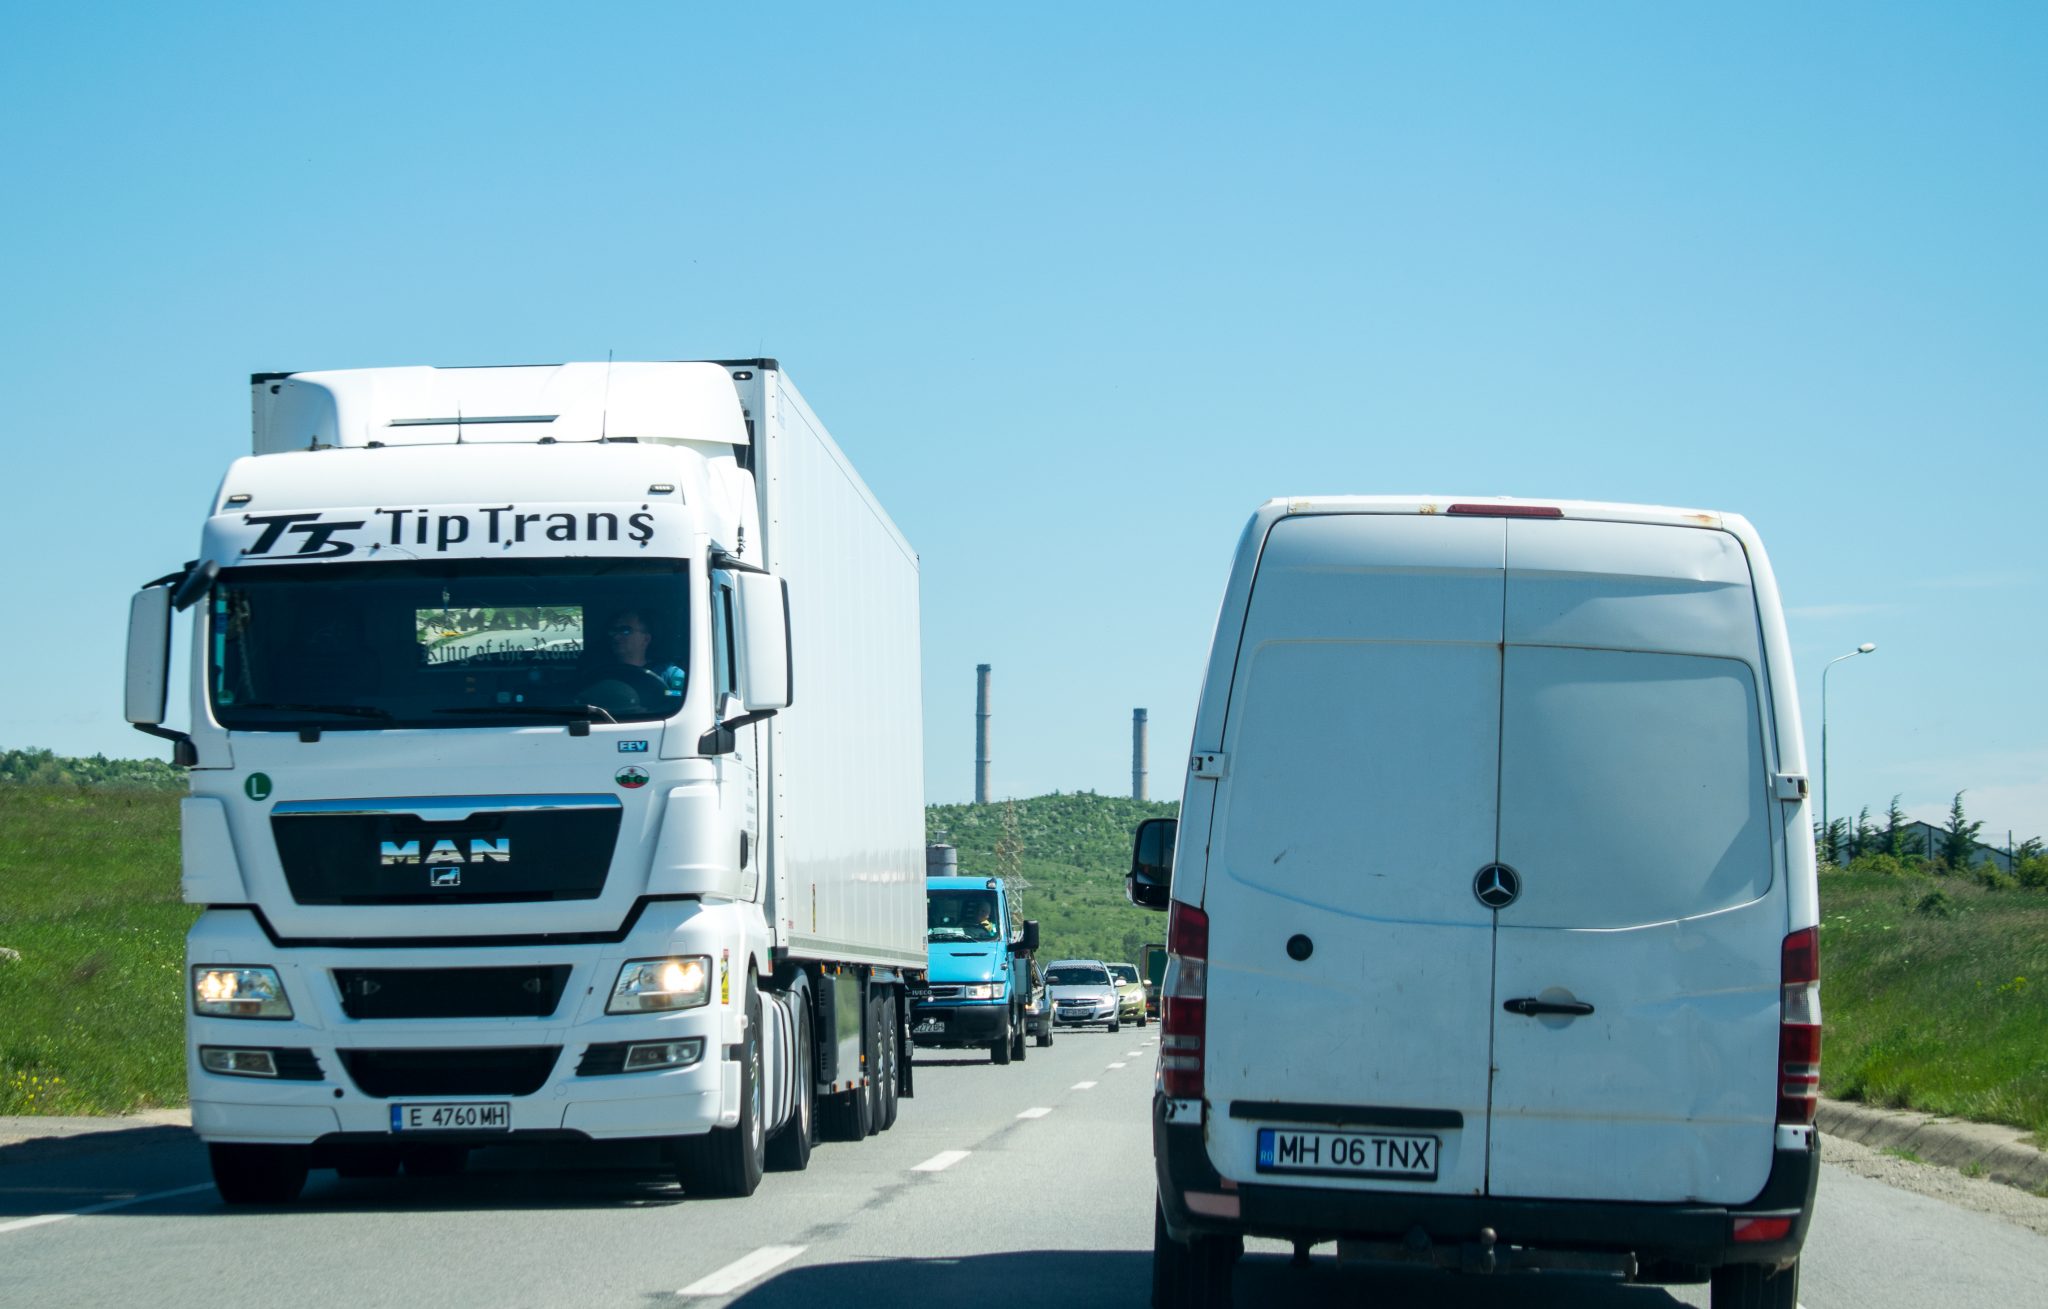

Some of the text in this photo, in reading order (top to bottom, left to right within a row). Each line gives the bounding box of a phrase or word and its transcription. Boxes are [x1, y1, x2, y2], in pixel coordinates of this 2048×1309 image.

[457, 610, 540, 631] MAN
[475, 639, 492, 661] of
[499, 639, 524, 662] the
[620, 741, 647, 751] EEV
[252, 777, 266, 798] L
[381, 838, 510, 865] MAN
[410, 1108, 423, 1126] E
[1260, 1151, 1273, 1162] RO
[1279, 1135, 1431, 1169] MH 06 TNX
